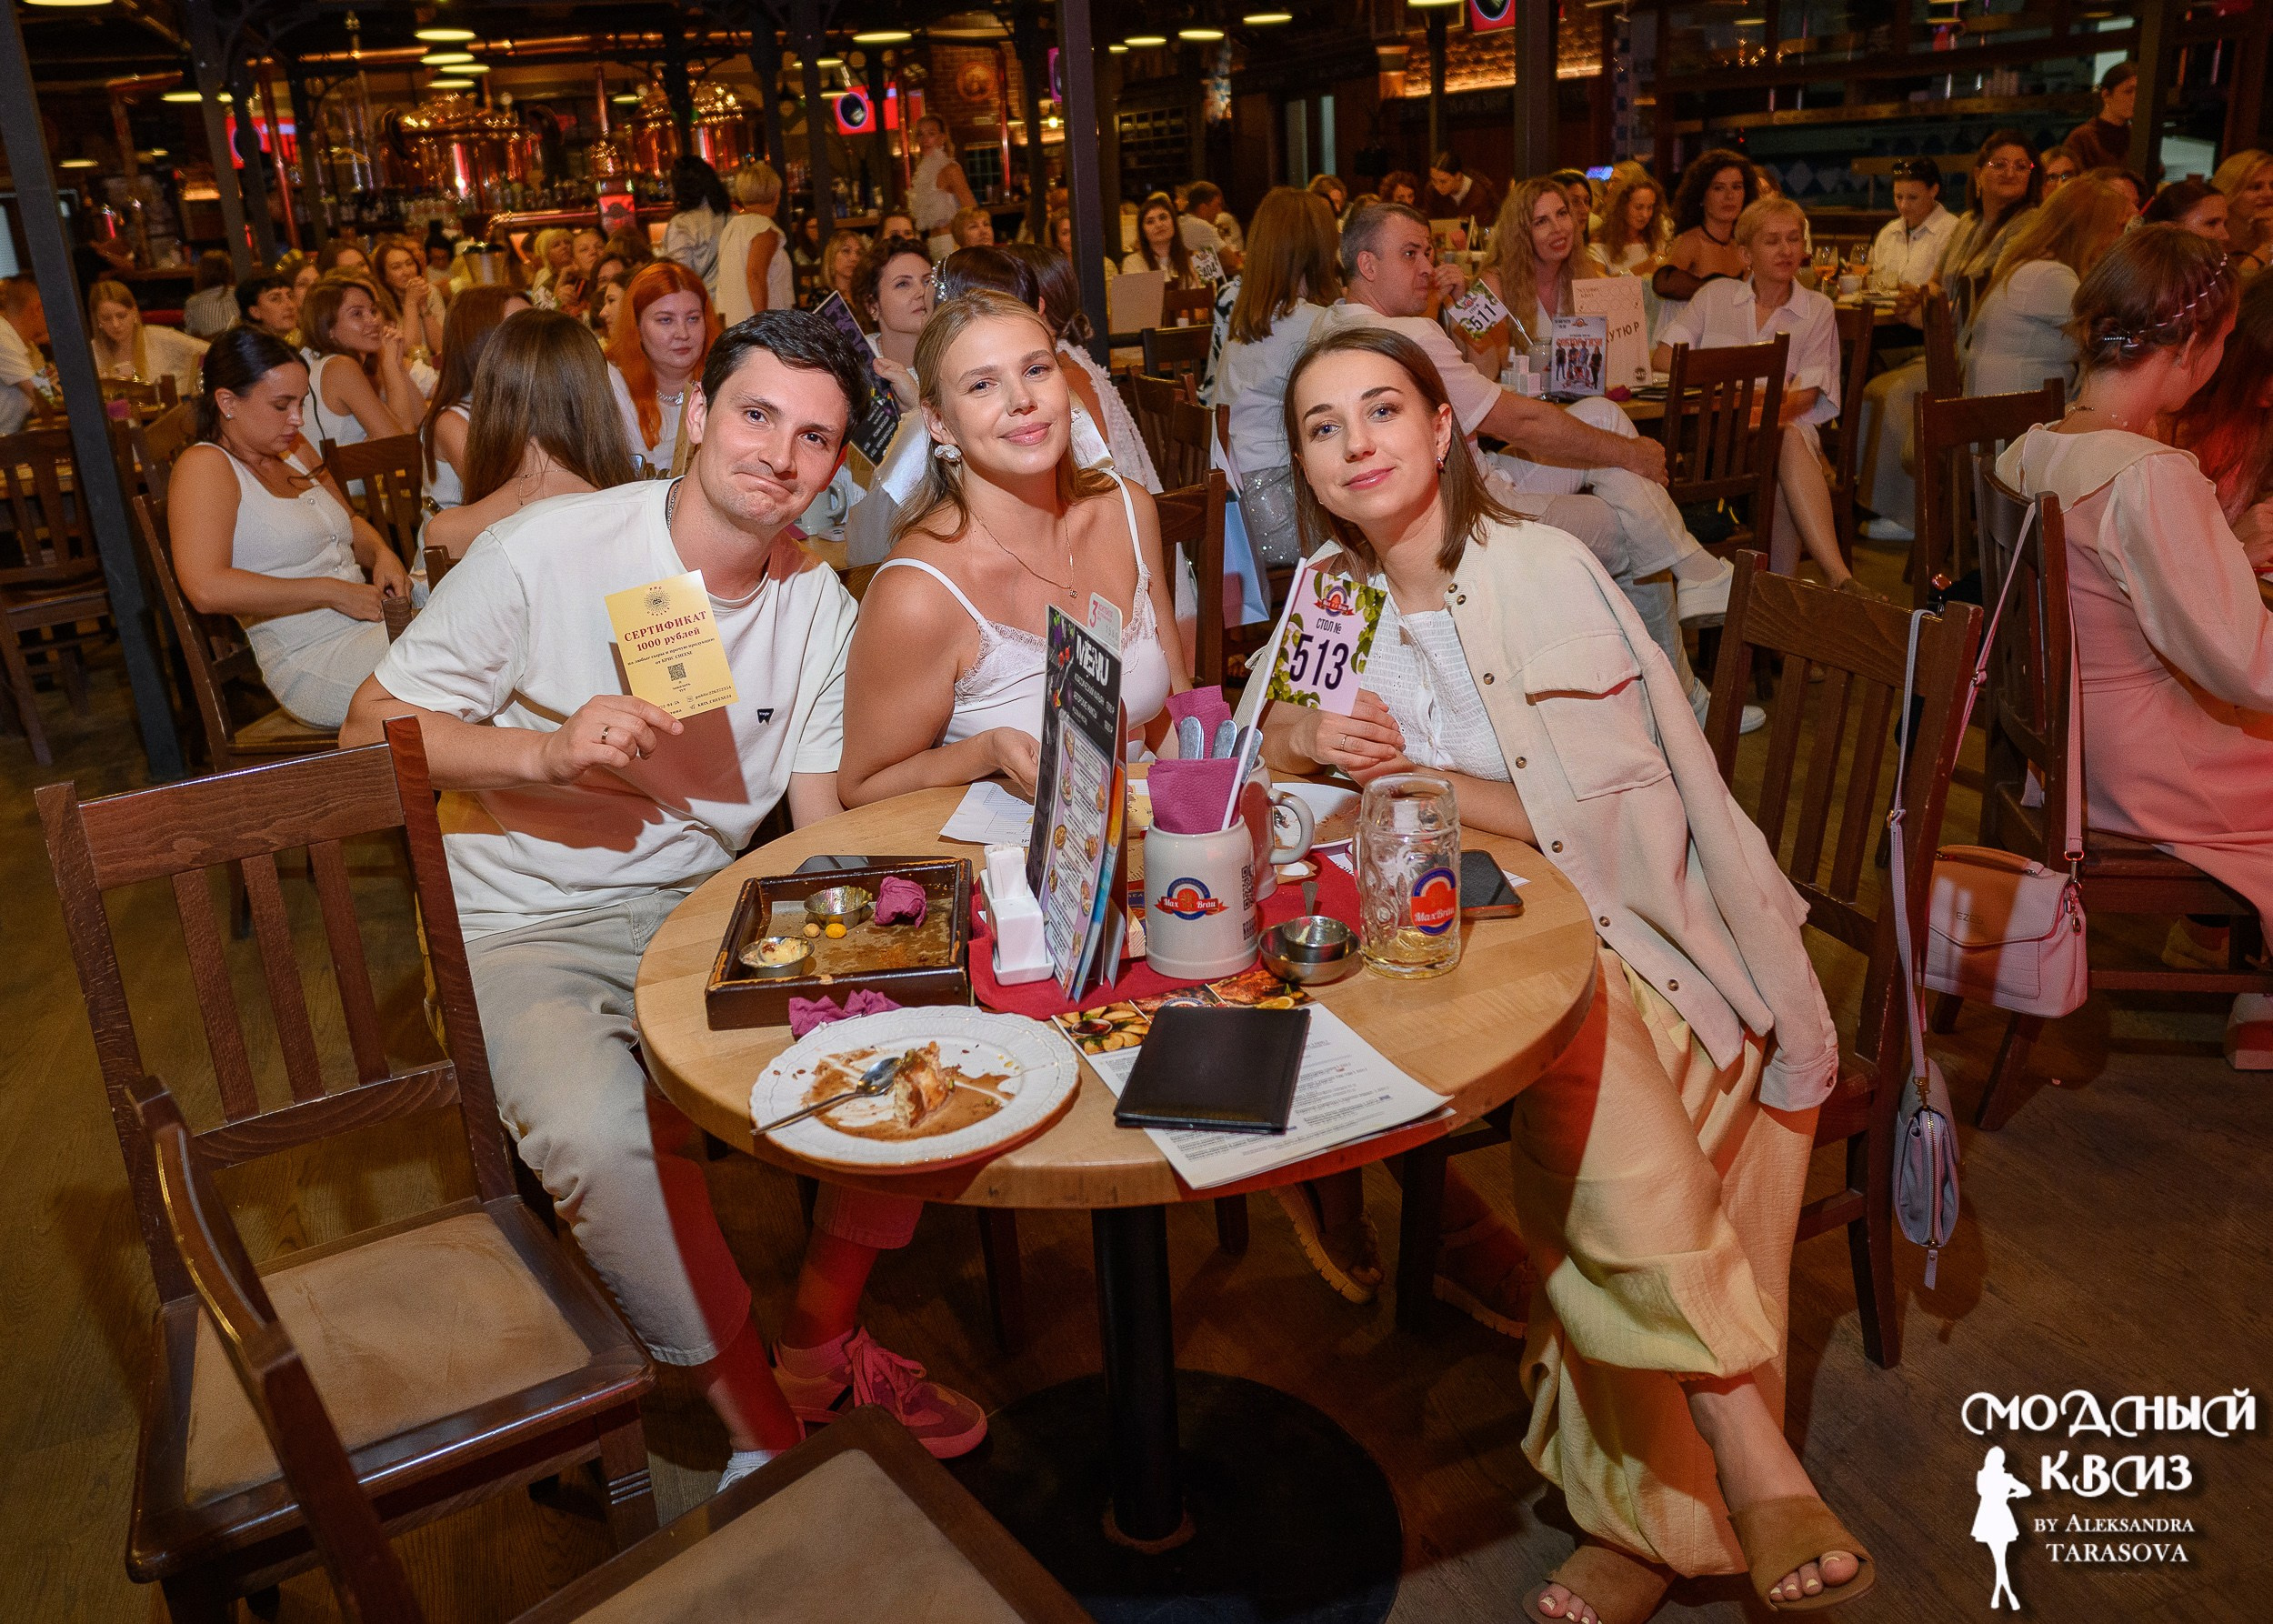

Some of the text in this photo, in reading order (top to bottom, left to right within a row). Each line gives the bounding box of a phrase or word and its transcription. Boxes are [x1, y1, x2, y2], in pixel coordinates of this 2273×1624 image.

[1470, 303, 1497, 331] 511
[624, 610, 707, 642] СЕРТИФИКАТ
[636, 627, 701, 652] 1000 рублей
[1316, 617, 1343, 635] СТОЛ №
[1076, 634, 1109, 687] MENU
[1290, 633, 1349, 690] 513
[1164, 897, 1179, 908] Max
